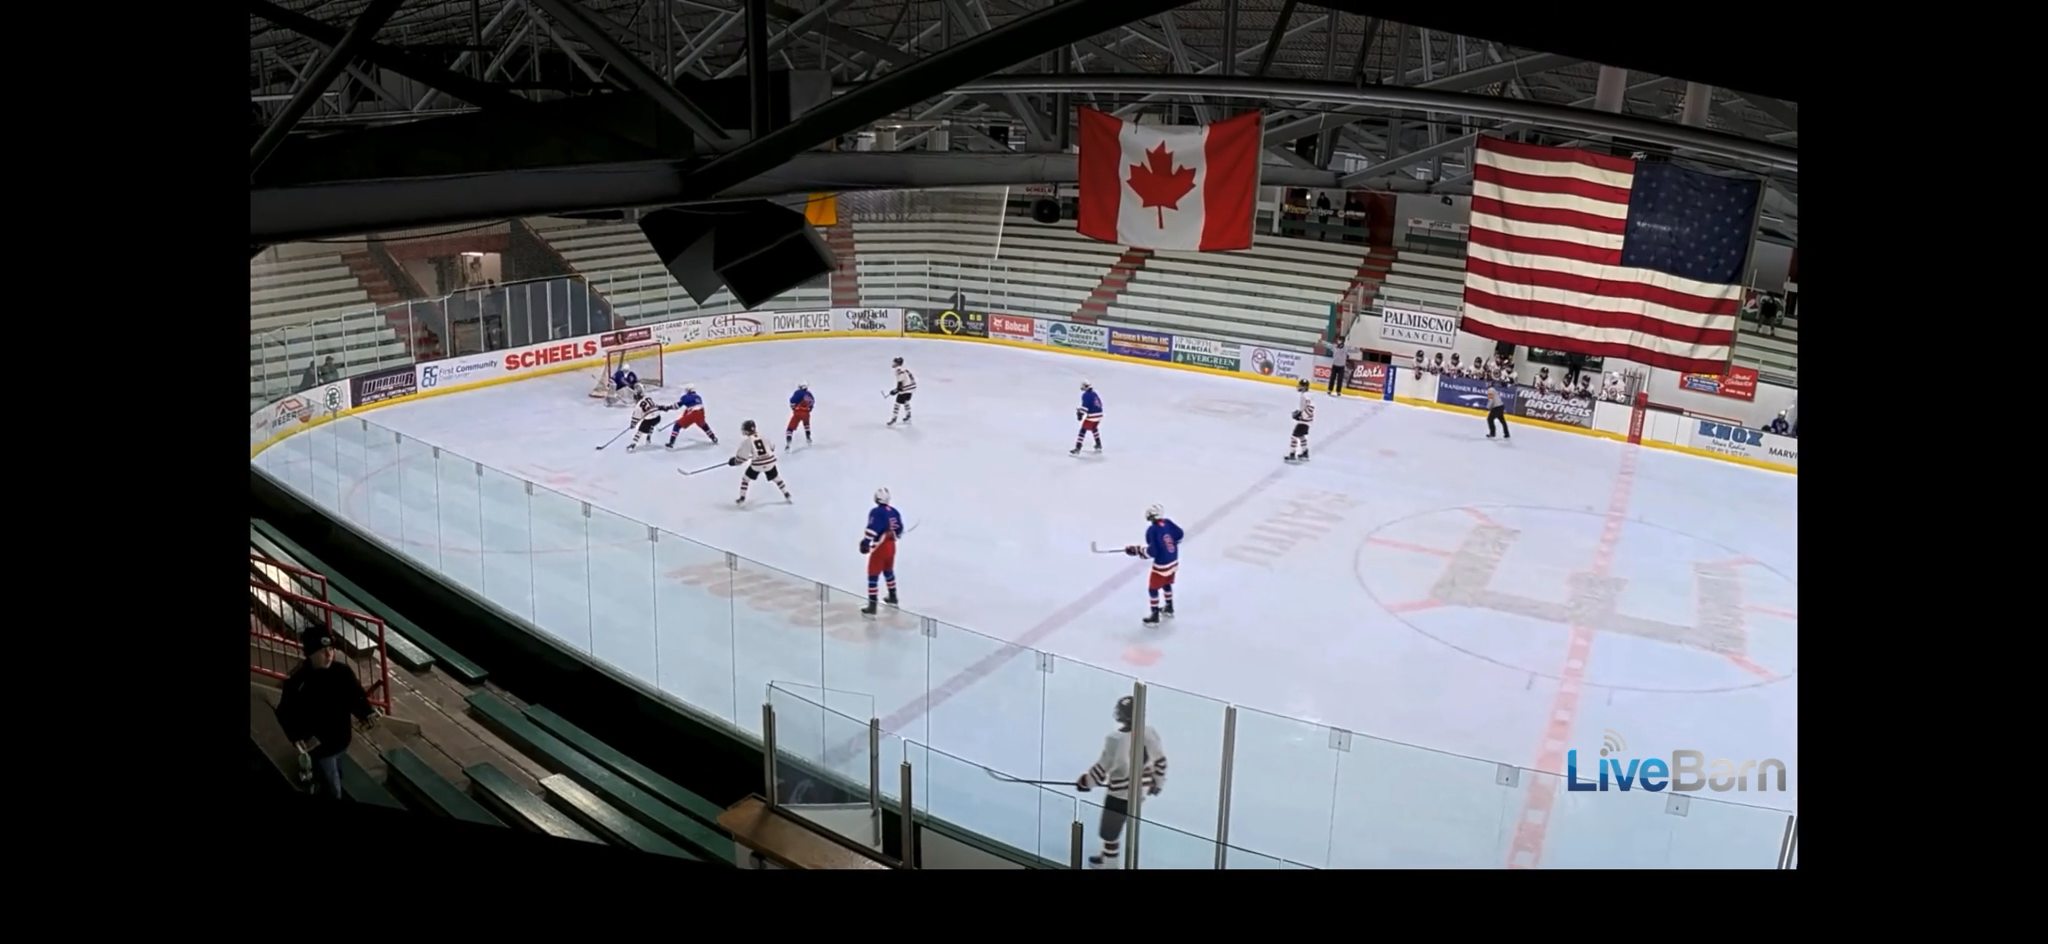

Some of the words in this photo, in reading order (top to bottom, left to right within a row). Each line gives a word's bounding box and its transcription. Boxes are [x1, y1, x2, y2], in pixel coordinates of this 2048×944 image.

[665, 321, 683, 330] GRAND
[1004, 320, 1030, 333] Bobcat
[1384, 310, 1453, 332] PALMISCNO
[1383, 328, 1452, 345] FINANCIAL
[505, 340, 598, 370] SCHEELS
[1175, 344, 1212, 353] FINANCIAL
[1186, 352, 1235, 366] EVERGREEN
[439, 367, 454, 376] First
[455, 360, 498, 373] Community
[1353, 364, 1385, 377] Bert's
[1525, 399, 1593, 417] BROTHERS
[1698, 420, 1764, 447] KNOX
[753, 439, 766, 456] 9
